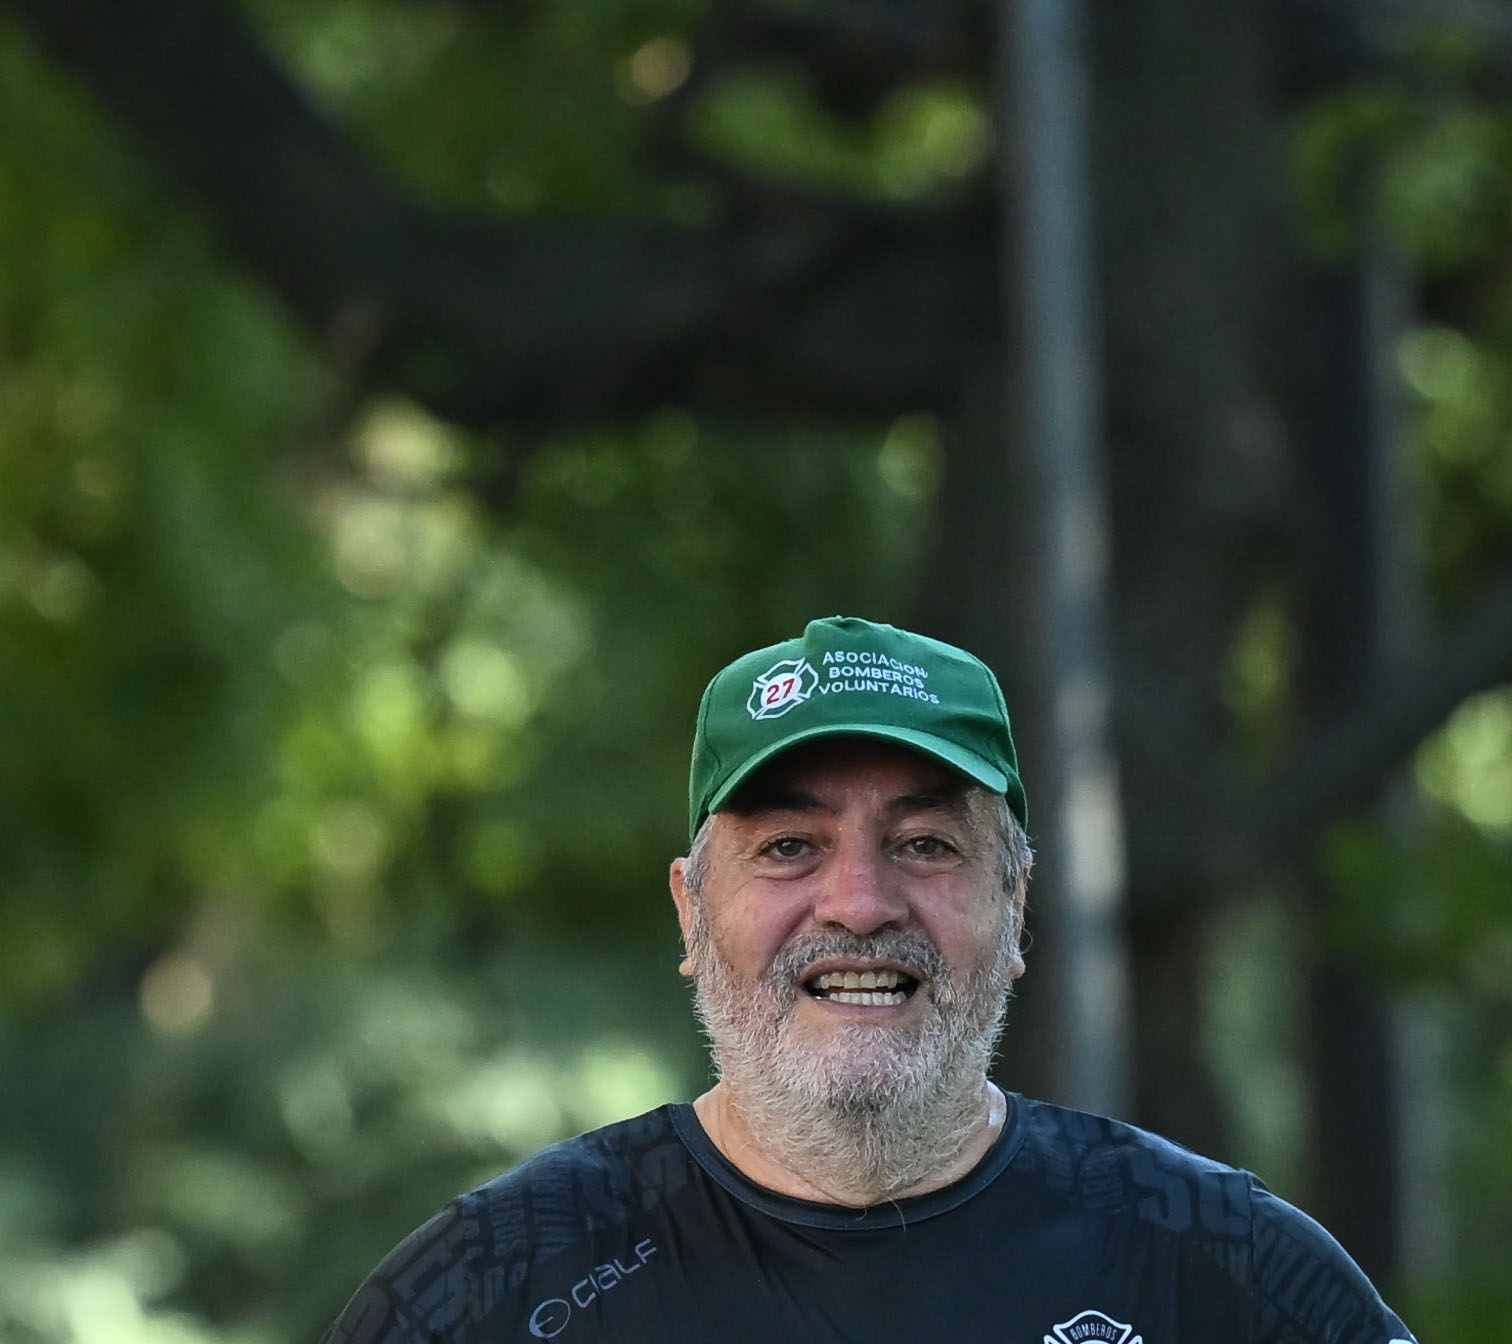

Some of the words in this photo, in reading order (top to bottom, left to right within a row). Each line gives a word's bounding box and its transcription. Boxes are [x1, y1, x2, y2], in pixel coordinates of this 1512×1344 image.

[822, 651, 929, 679] ASOCIACION
[829, 666, 925, 689] BOMBEROS
[766, 678, 795, 705] 27
[819, 680, 940, 704] VOLUNTARIOS
[1070, 1322, 1118, 1341] BOMBEROS
